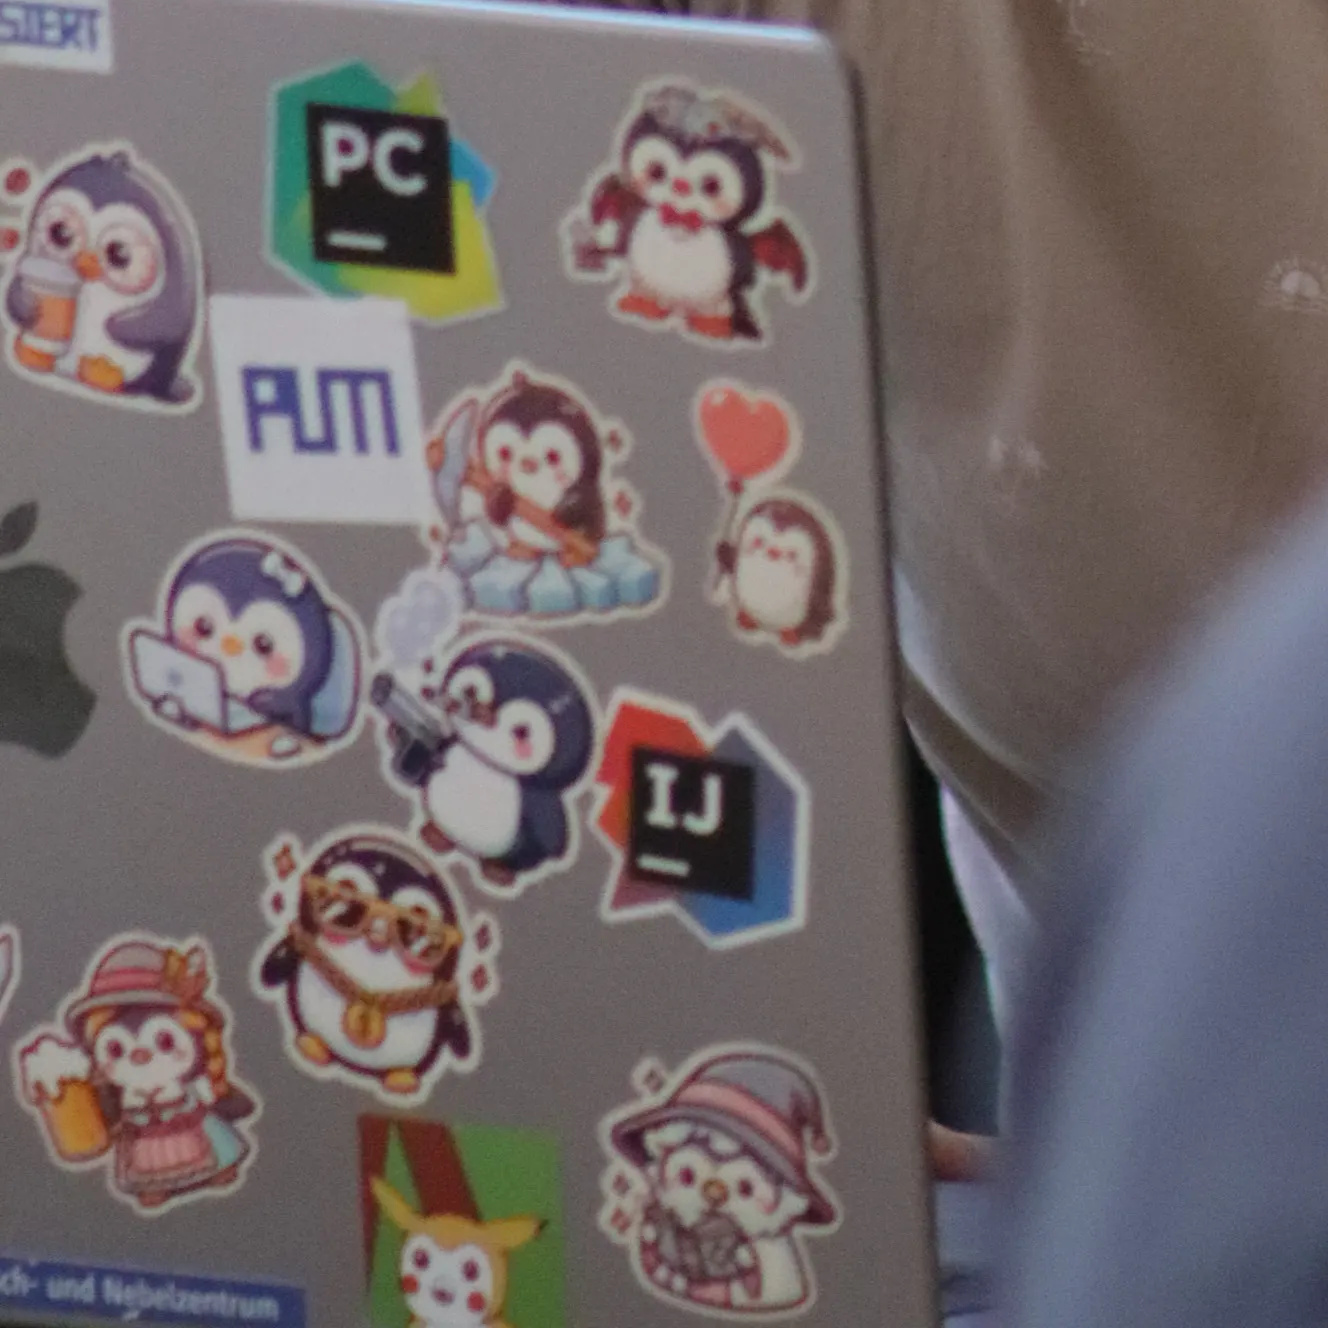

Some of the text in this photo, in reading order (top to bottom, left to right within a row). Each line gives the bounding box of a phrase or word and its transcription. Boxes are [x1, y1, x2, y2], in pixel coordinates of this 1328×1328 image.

[320, 120, 427, 196] PC
[645, 762, 721, 835] IJ
[47, 1273, 95, 1304] und
